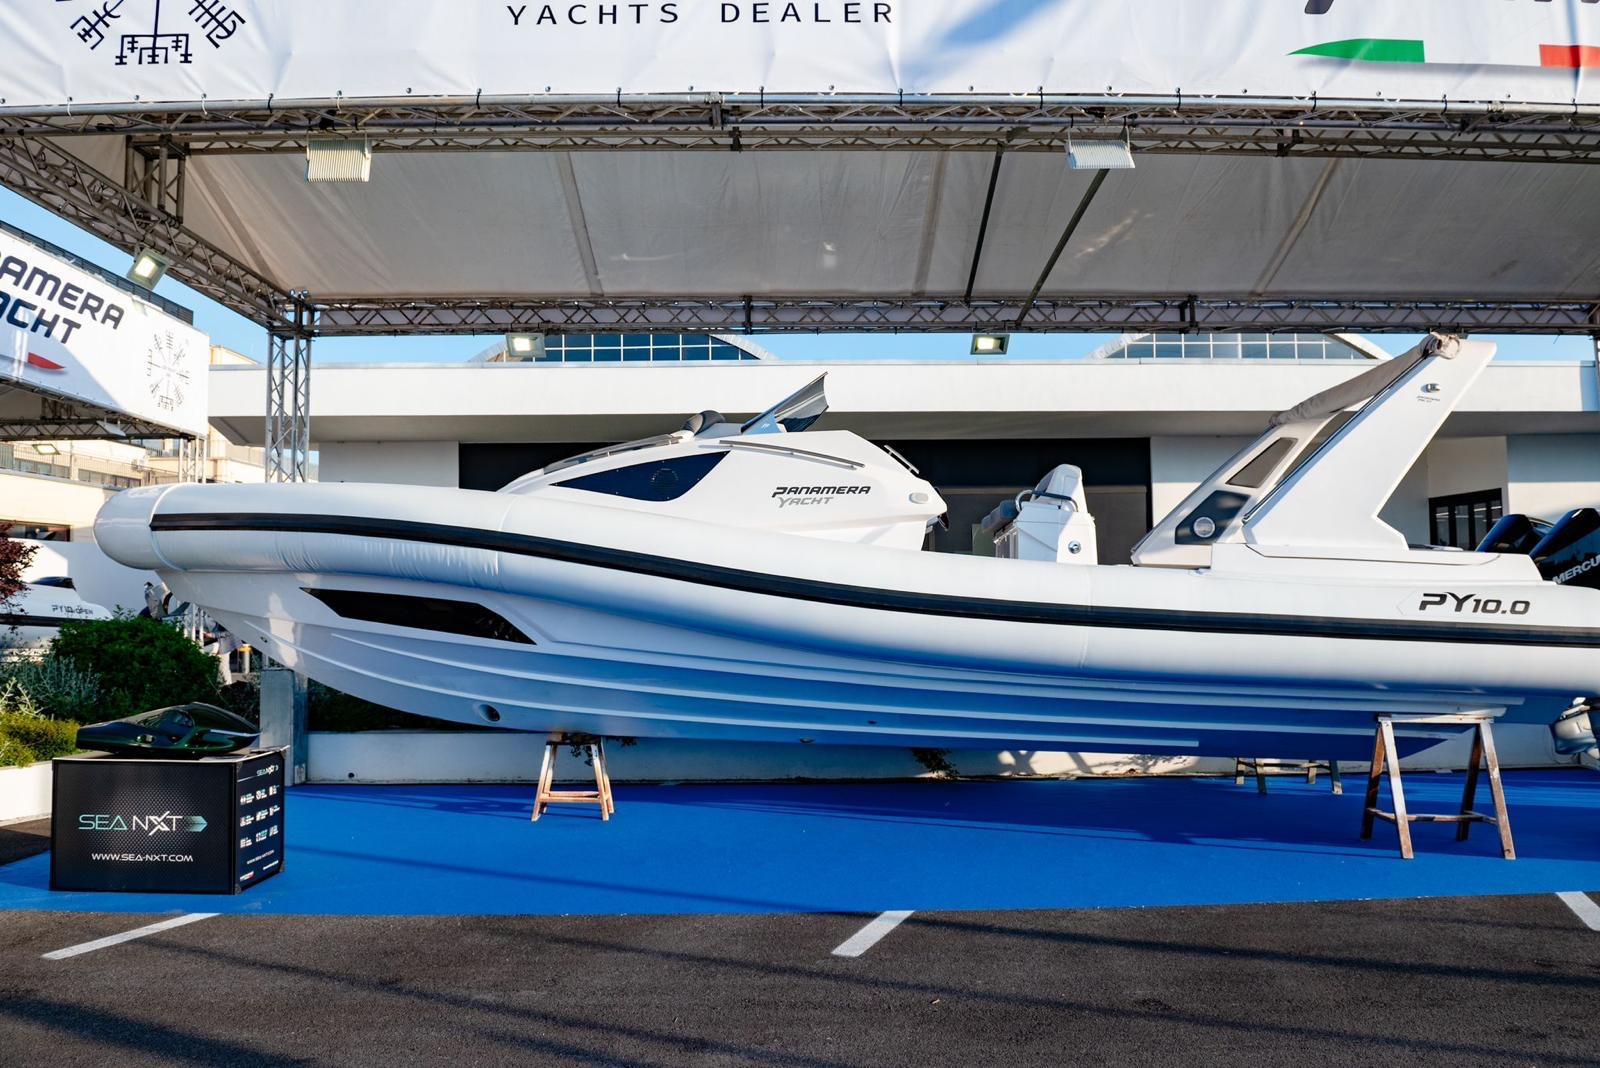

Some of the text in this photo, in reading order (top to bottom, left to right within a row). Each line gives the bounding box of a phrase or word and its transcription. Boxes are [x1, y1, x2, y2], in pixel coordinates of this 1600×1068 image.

[507, 2, 892, 25] YACHTS DEALER
[0, 254, 125, 330] AMERA
[772, 486, 871, 498] PANAMERA
[778, 496, 834, 509] YACHT
[1418, 591, 1531, 615] PY10.0
[78, 811, 183, 836] SEA NXT
[91, 852, 194, 863] WWW.SEA-NXT.COM
